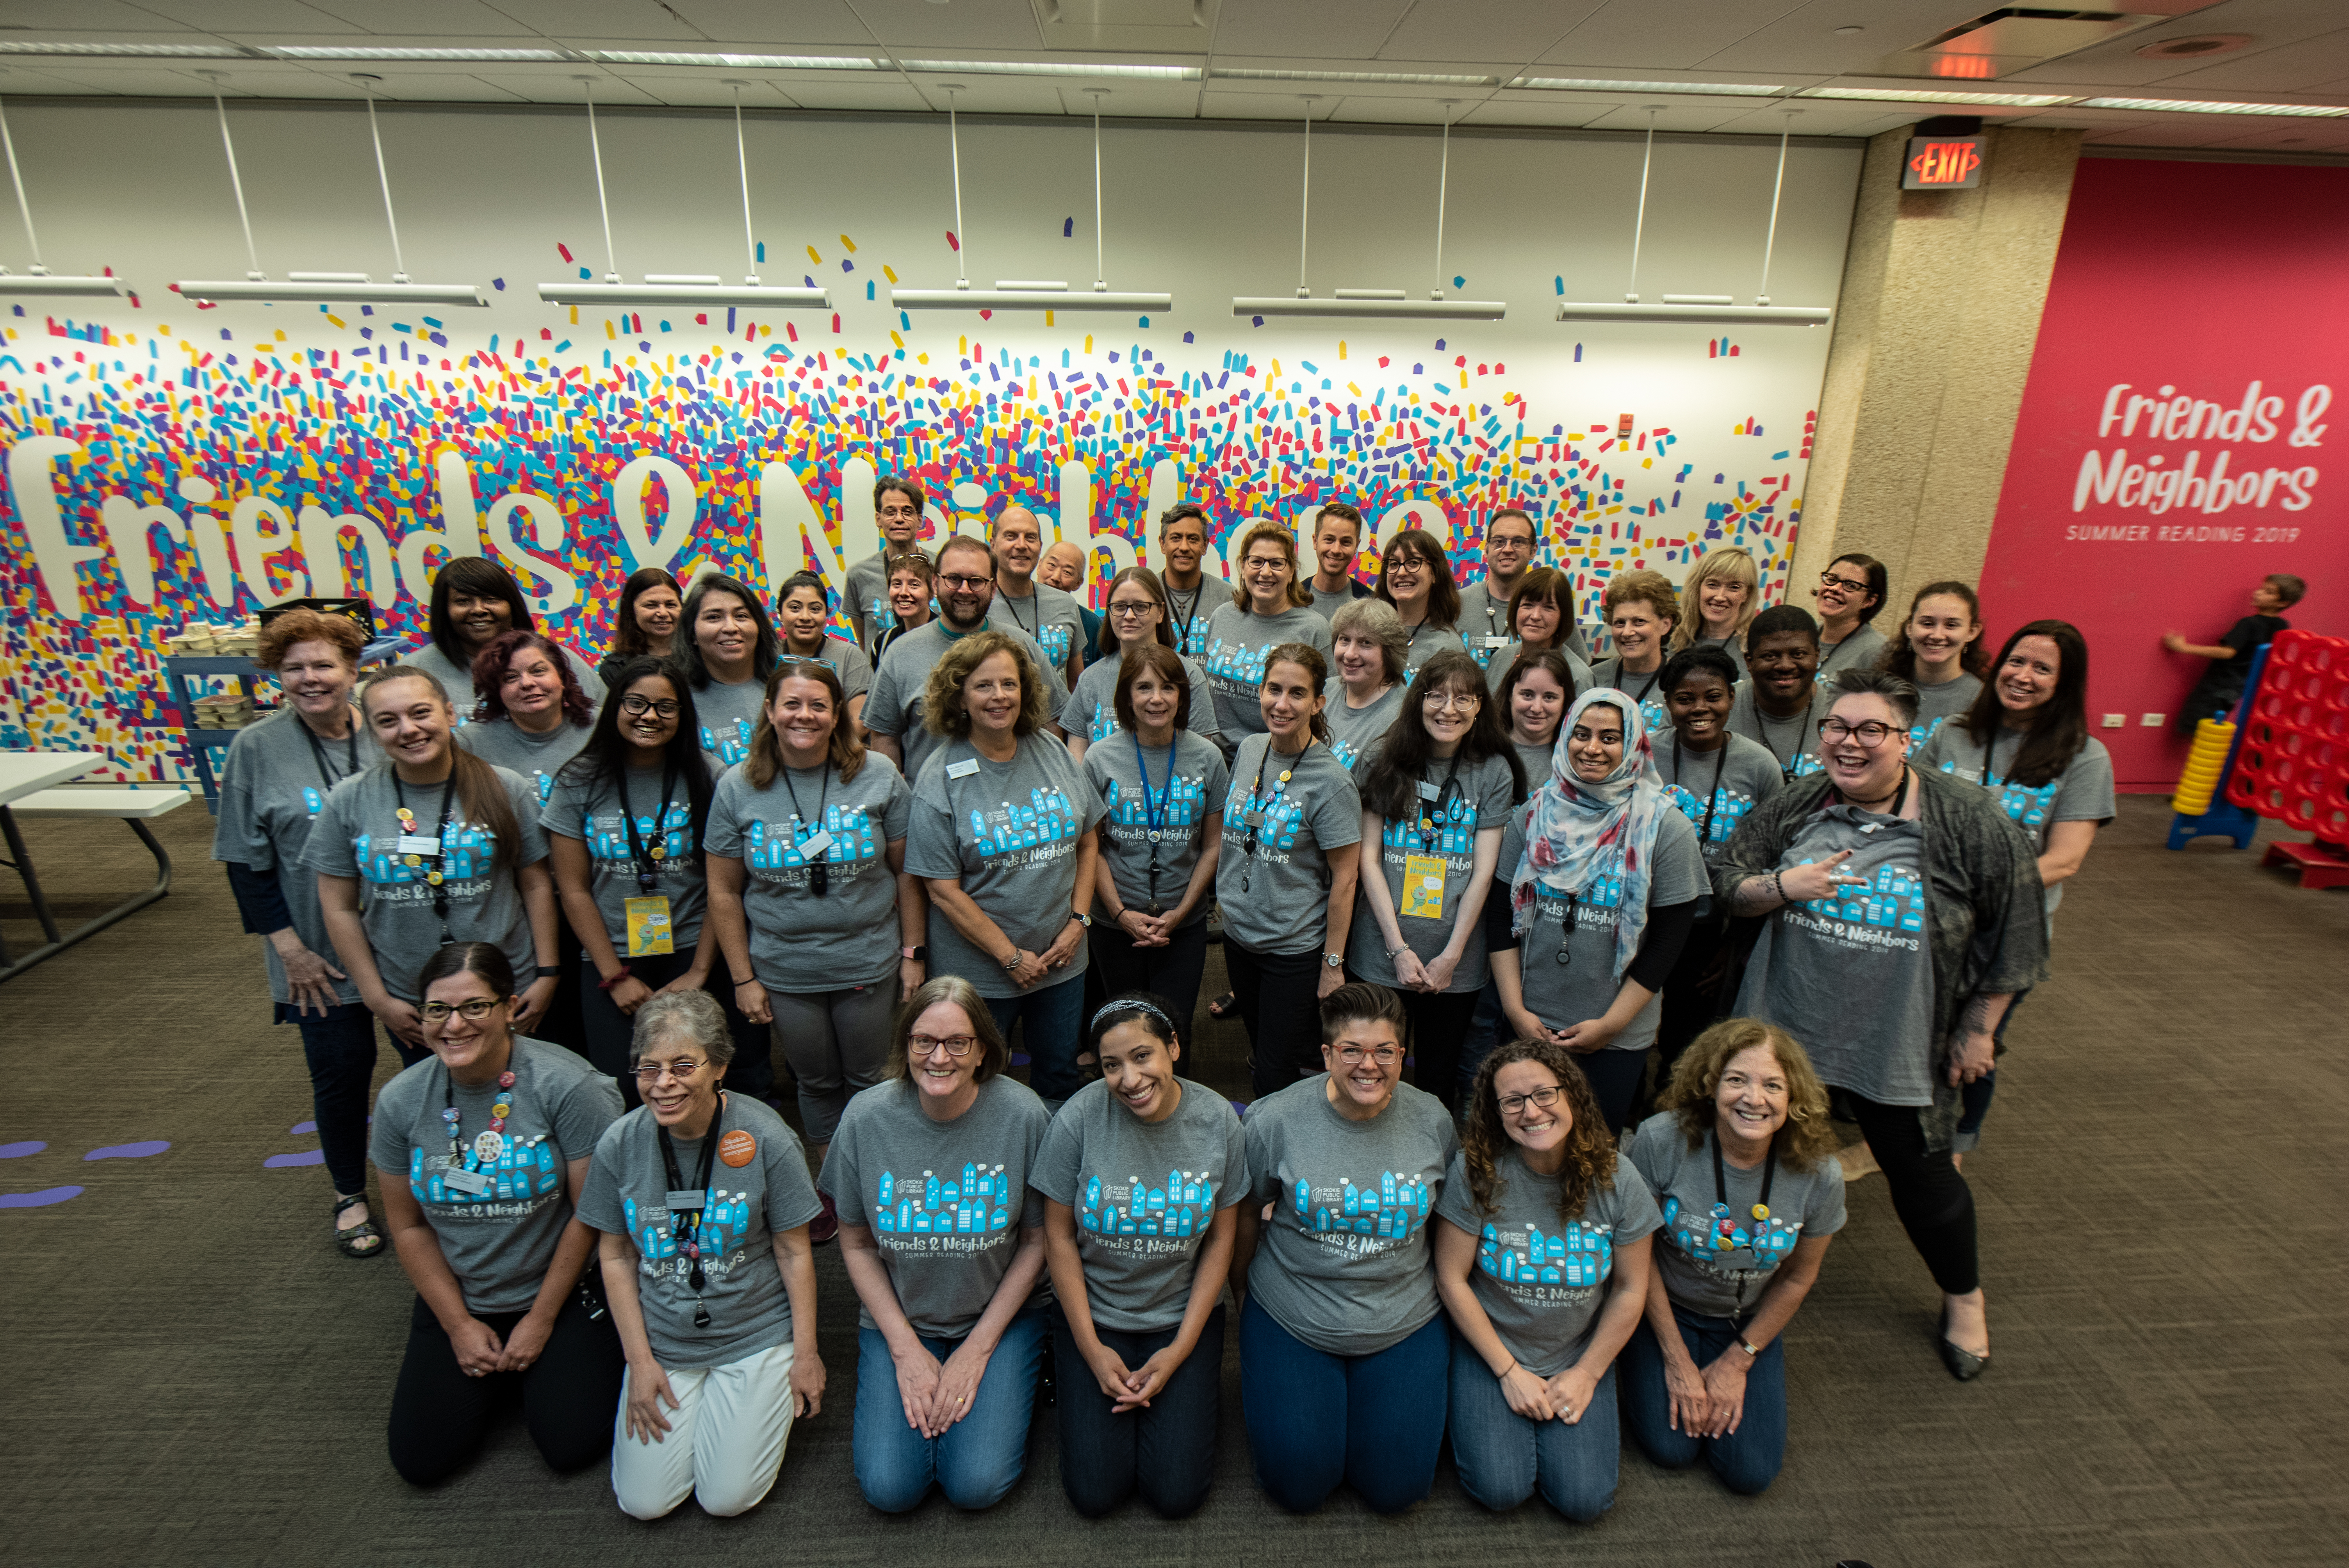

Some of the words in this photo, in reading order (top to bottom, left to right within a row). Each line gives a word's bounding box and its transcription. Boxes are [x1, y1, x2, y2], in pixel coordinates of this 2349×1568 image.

[1919, 143, 1976, 183] EXIT
[2099, 380, 2285, 443] Friends
[2288, 384, 2333, 448] &
[2072, 449, 2319, 515] Neighbors
[9, 435, 577, 621] Friends
[2065, 525, 2151, 542] SUMMER
[2157, 526, 2246, 542] READING
[2252, 527, 2301, 543] 2019
[1230, 682, 1235, 693] &
[1237, 685, 1260, 697] Neigh
[1112, 826, 1144, 840] Friends
[1159, 826, 1199, 841] Neighbs
[1221, 830, 1241, 845] ends
[1256, 840, 1289, 864] hbors
[984, 855, 1019, 870] Friends
[1021, 852, 1028, 863] &
[1030, 842, 1075, 862] Neighbors
[1385, 851, 1408, 864] riend
[756, 870, 800, 882] Friends
[826, 860, 877, 877] eighbors
[1025, 862, 1048, 870] READING
[1538, 899, 1563, 916] iends
[1578, 907, 1614, 925] Neigh
[1544, 915, 1563, 925] SUMM
[1575, 922, 1596, 931] ADING
[1783, 910, 1832, 934] Friends
[1834, 923, 1845, 937] &
[1847, 926, 1919, 951] Neighbors
[1839, 939, 1868, 951] READING
[724, 1136, 747, 1145] Skokie
[471, 1205, 484, 1218] &
[879, 1235, 926, 1251] Friends
[929, 1237, 939, 1251] &
[943, 1233, 1006, 1252] Neighbors
[1134, 1239, 1143, 1252] &
[1321, 1244, 1348, 1258] SUMMER
[1347, 1234, 1357, 1251] &
[676, 1258, 687, 1274] &
[691, 1251, 745, 1275] ighbors
[1108, 1250, 1135, 1259] SUMMER
[1139, 1252, 1167, 1260] READING
[1536, 1287, 1546, 1299] &
